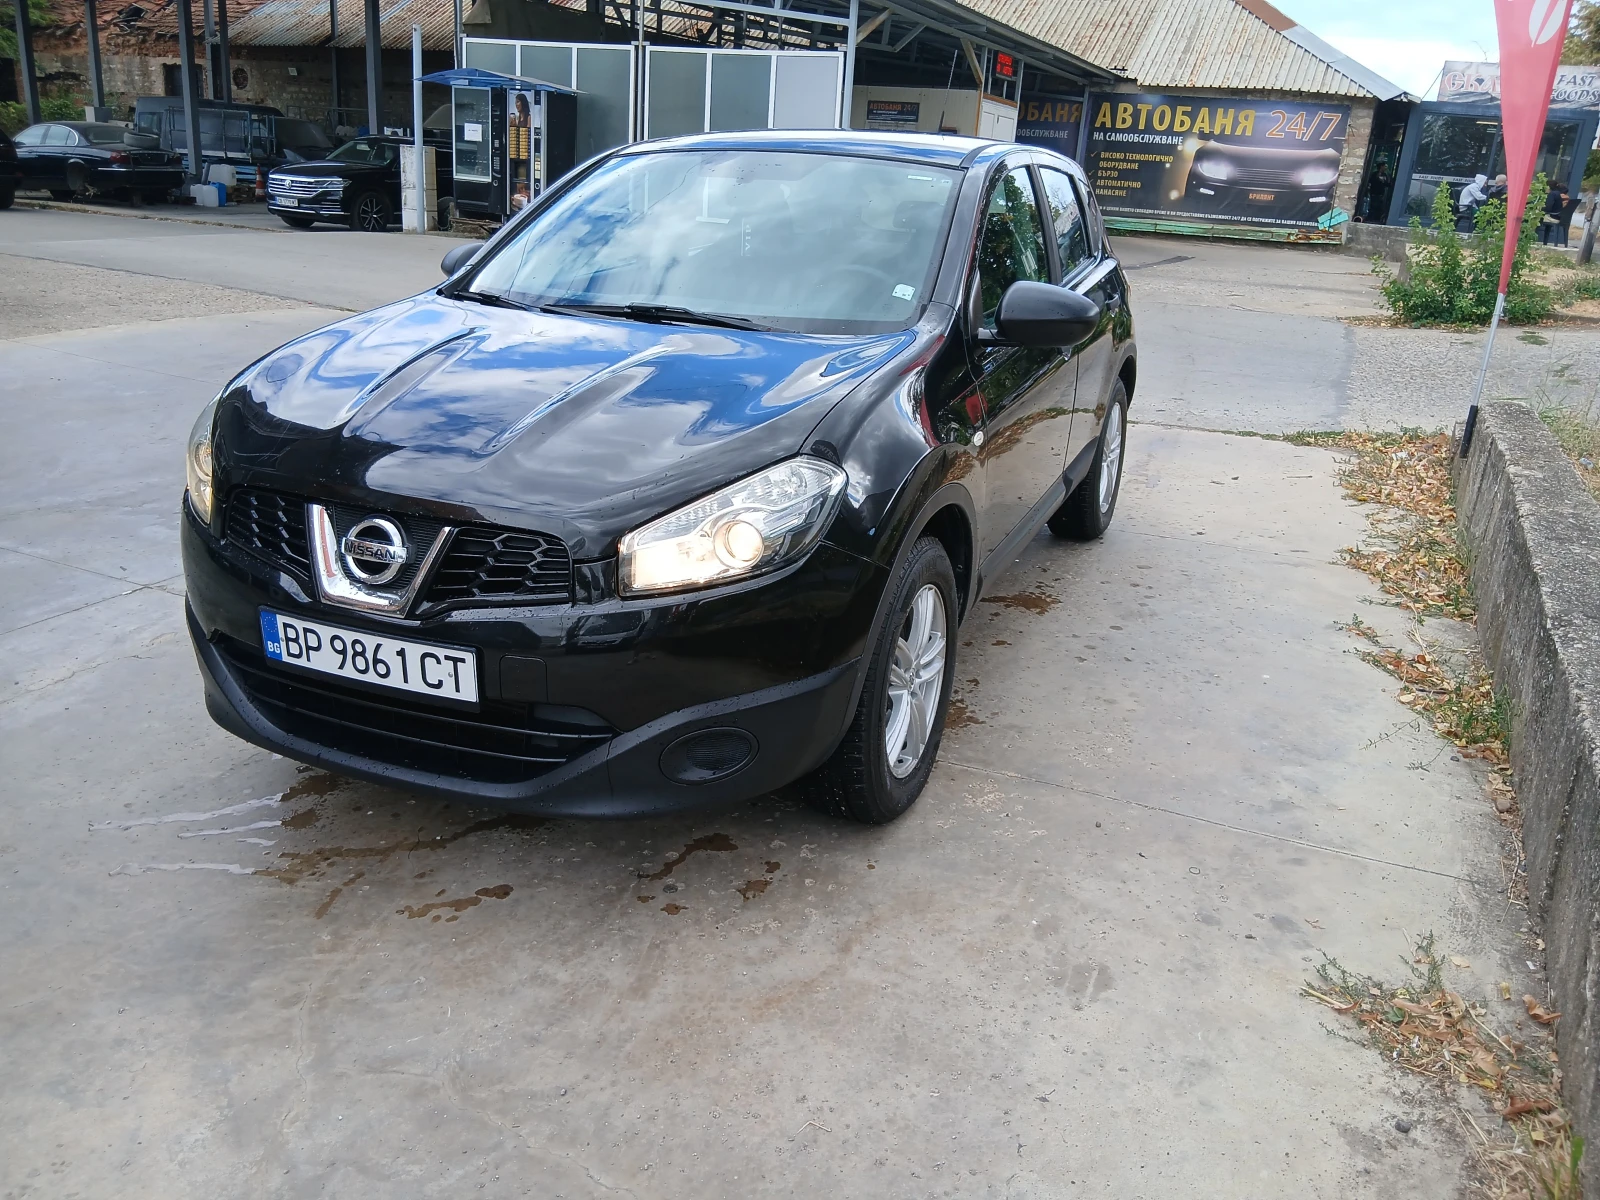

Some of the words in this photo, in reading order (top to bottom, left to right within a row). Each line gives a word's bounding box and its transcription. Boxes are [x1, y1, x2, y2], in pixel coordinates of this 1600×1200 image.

[1557, 74, 1596, 86] FAST
[1094, 102, 1256, 136] АВТОБАНЯ
[1265, 109, 1342, 142] 24/7
[1093, 131, 1104, 141] НА
[1106, 132, 1184, 145] САМООБСЛУЖВАНЕ
[1100, 151, 1125, 160] ВИСОКО
[1126, 153, 1174, 163] ТЕХНОЛОГИЧНО
[1099, 161, 1139, 170] ОБОРУДВАНЕ
[1097, 170, 1119, 178] БЪРЗО
[1096, 180, 1142, 189] АВТОМАТИЧНО
[1095, 188, 1127, 197] НАНАСЯНЕ
[346, 540, 396, 562] NISSAN
[268, 641, 281, 654] BG
[329, 634, 409, 684] 9861
